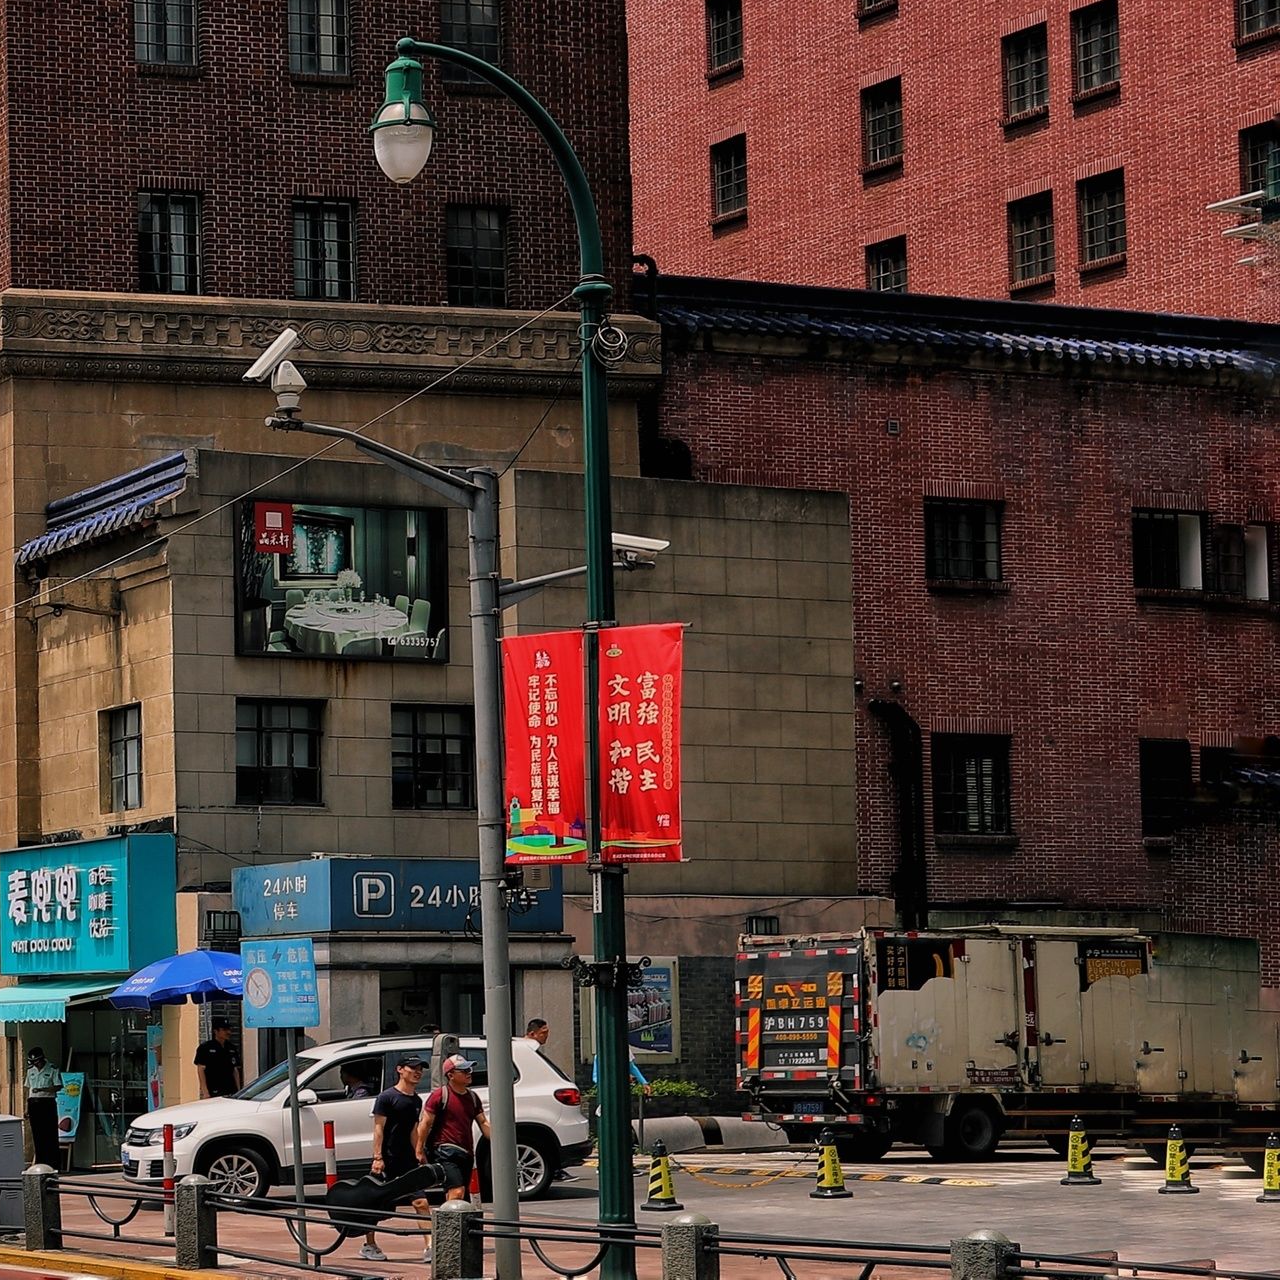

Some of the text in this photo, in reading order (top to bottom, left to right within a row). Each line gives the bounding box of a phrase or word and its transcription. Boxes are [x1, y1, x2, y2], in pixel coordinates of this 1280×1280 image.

[608, 674, 631, 726] 文明
[528, 675, 543, 816] 牢记使命 为民族谋复兴
[544, 674, 560, 815] 不忘初心 为人民谋幸福
[608, 739, 633, 795] 和谐
[636, 740, 660, 791] 民主
[88, 866, 108, 886] 面包
[263, 875, 308, 897] 24小时
[7, 864, 77, 926] 麦兜兜
[362, 877, 386, 912] P
[272, 902, 299, 921] 停车
[30, 938, 49, 952] DOU
[51, 937, 72, 952] DOU
[246, 946, 310, 964] 高压 危险
[1070, 1143, 1078, 1170] 禁止停车
[1168, 1152, 1177, 1179] 禁止停车
[1266, 1161, 1274, 1188] 禁止停车
